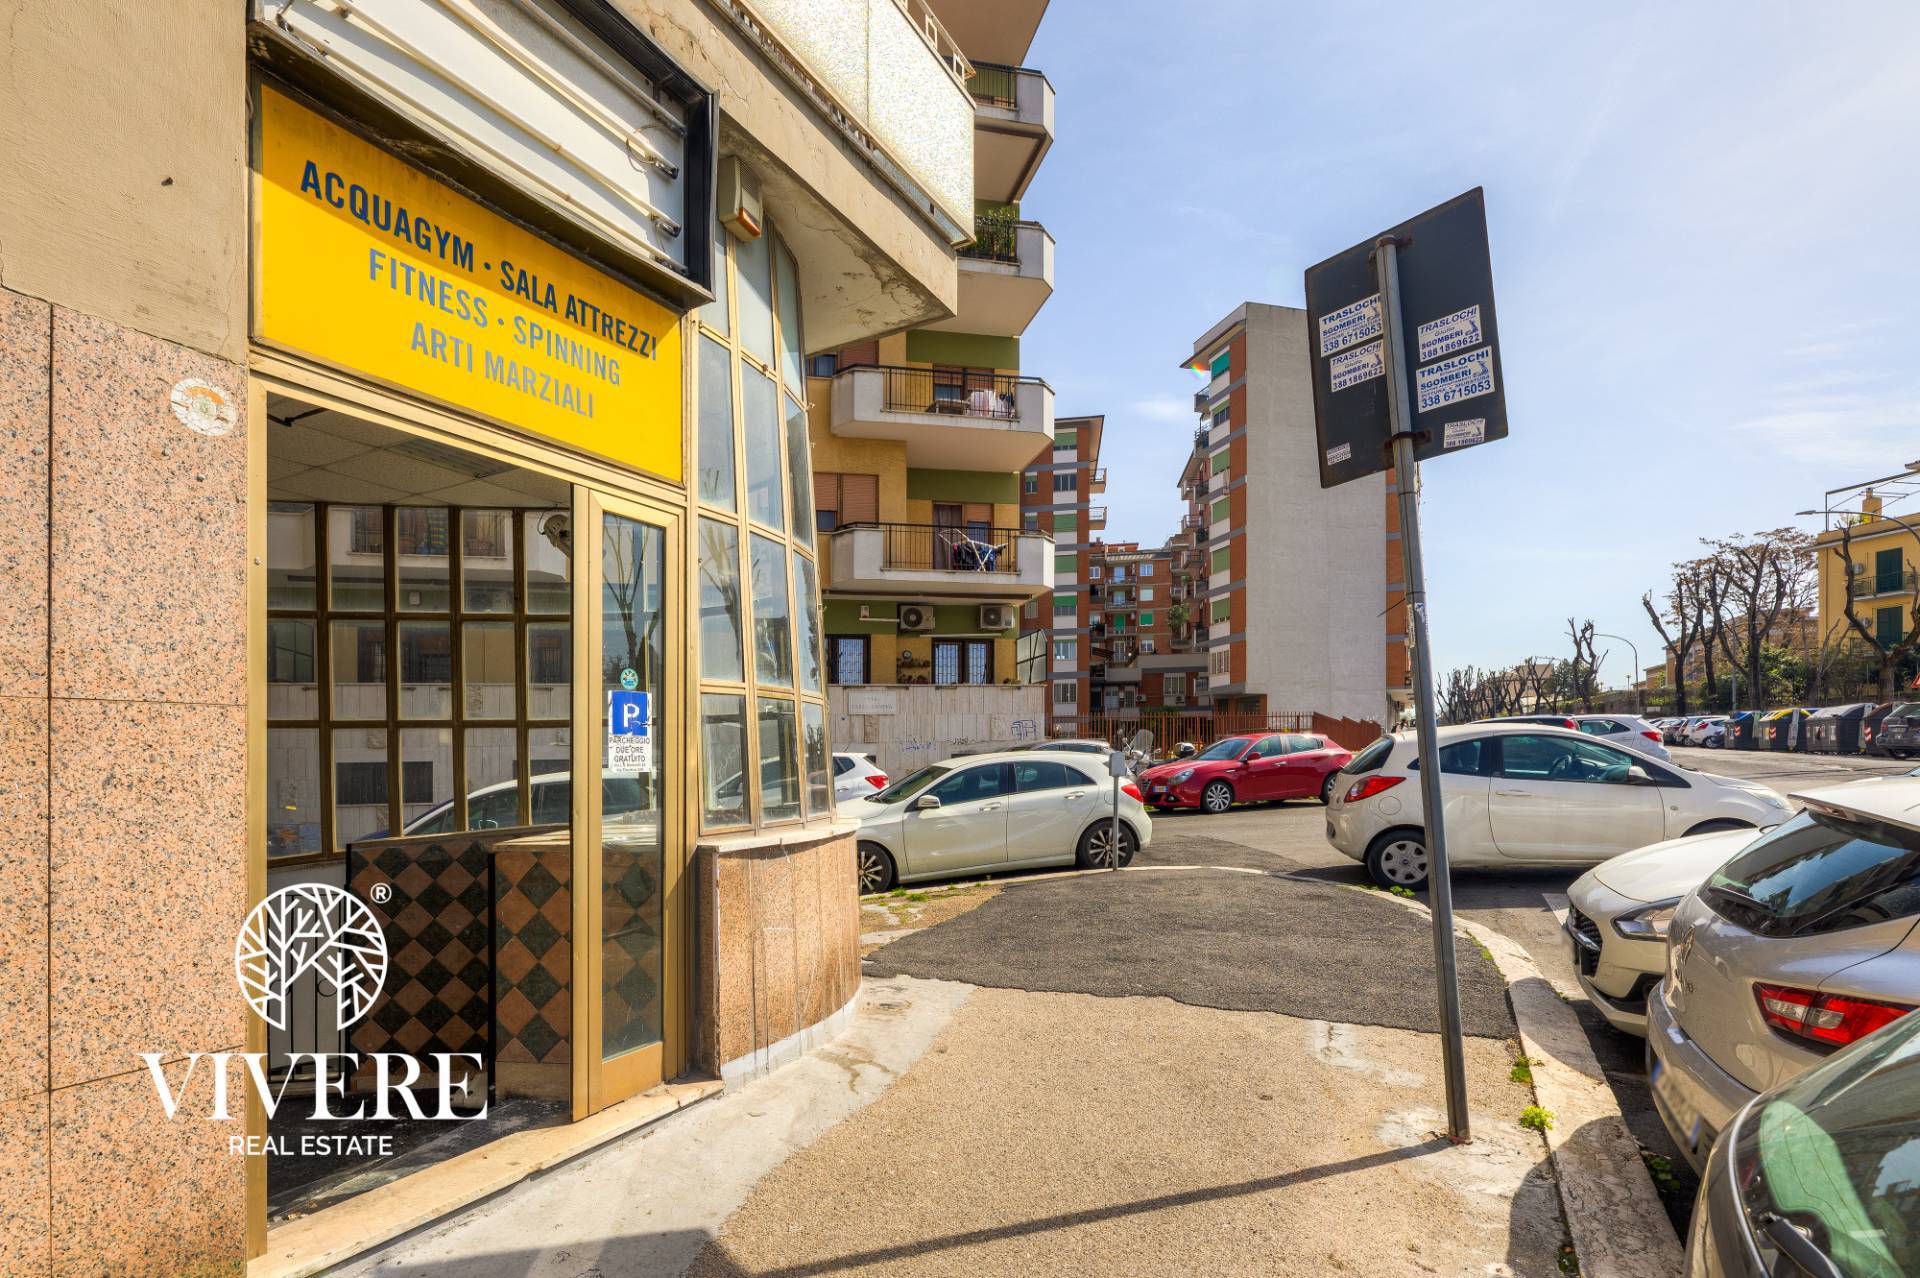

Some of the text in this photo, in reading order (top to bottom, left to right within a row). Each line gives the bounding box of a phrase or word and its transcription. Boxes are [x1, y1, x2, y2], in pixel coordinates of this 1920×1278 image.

[300, 159, 657, 361] ACQUAGYM SALA ATTREZZI
[369, 248, 620, 386] FITNESS SPINNING
[1322, 296, 1380, 325] TRASLOCHI
[1420, 307, 1477, 334] TRASLOCHI
[1323, 314, 1365, 336] SGOMBERI
[1324, 340, 1340, 353] 338
[1342, 323, 1382, 345] 6715053
[1421, 330, 1463, 349] SGOMBERI
[1440, 333, 1480, 353] 1869622
[1332, 341, 1382, 366] TRASLOCHI
[1420, 349, 1489, 377] TRASLOCHI
[411, 322, 594, 418] ARTI MARZIALI
[1333, 363, 1369, 380] SGOMBERI
[1333, 366, 1383, 390] 388 1869622
[1420, 369, 1471, 390] SGOMBERI
[1422, 395, 1440, 408] 338
[1444, 380, 1491, 401] 6715053
[624, 704, 639, 727] P
[609, 736, 650, 744] PARCHEGGIO
